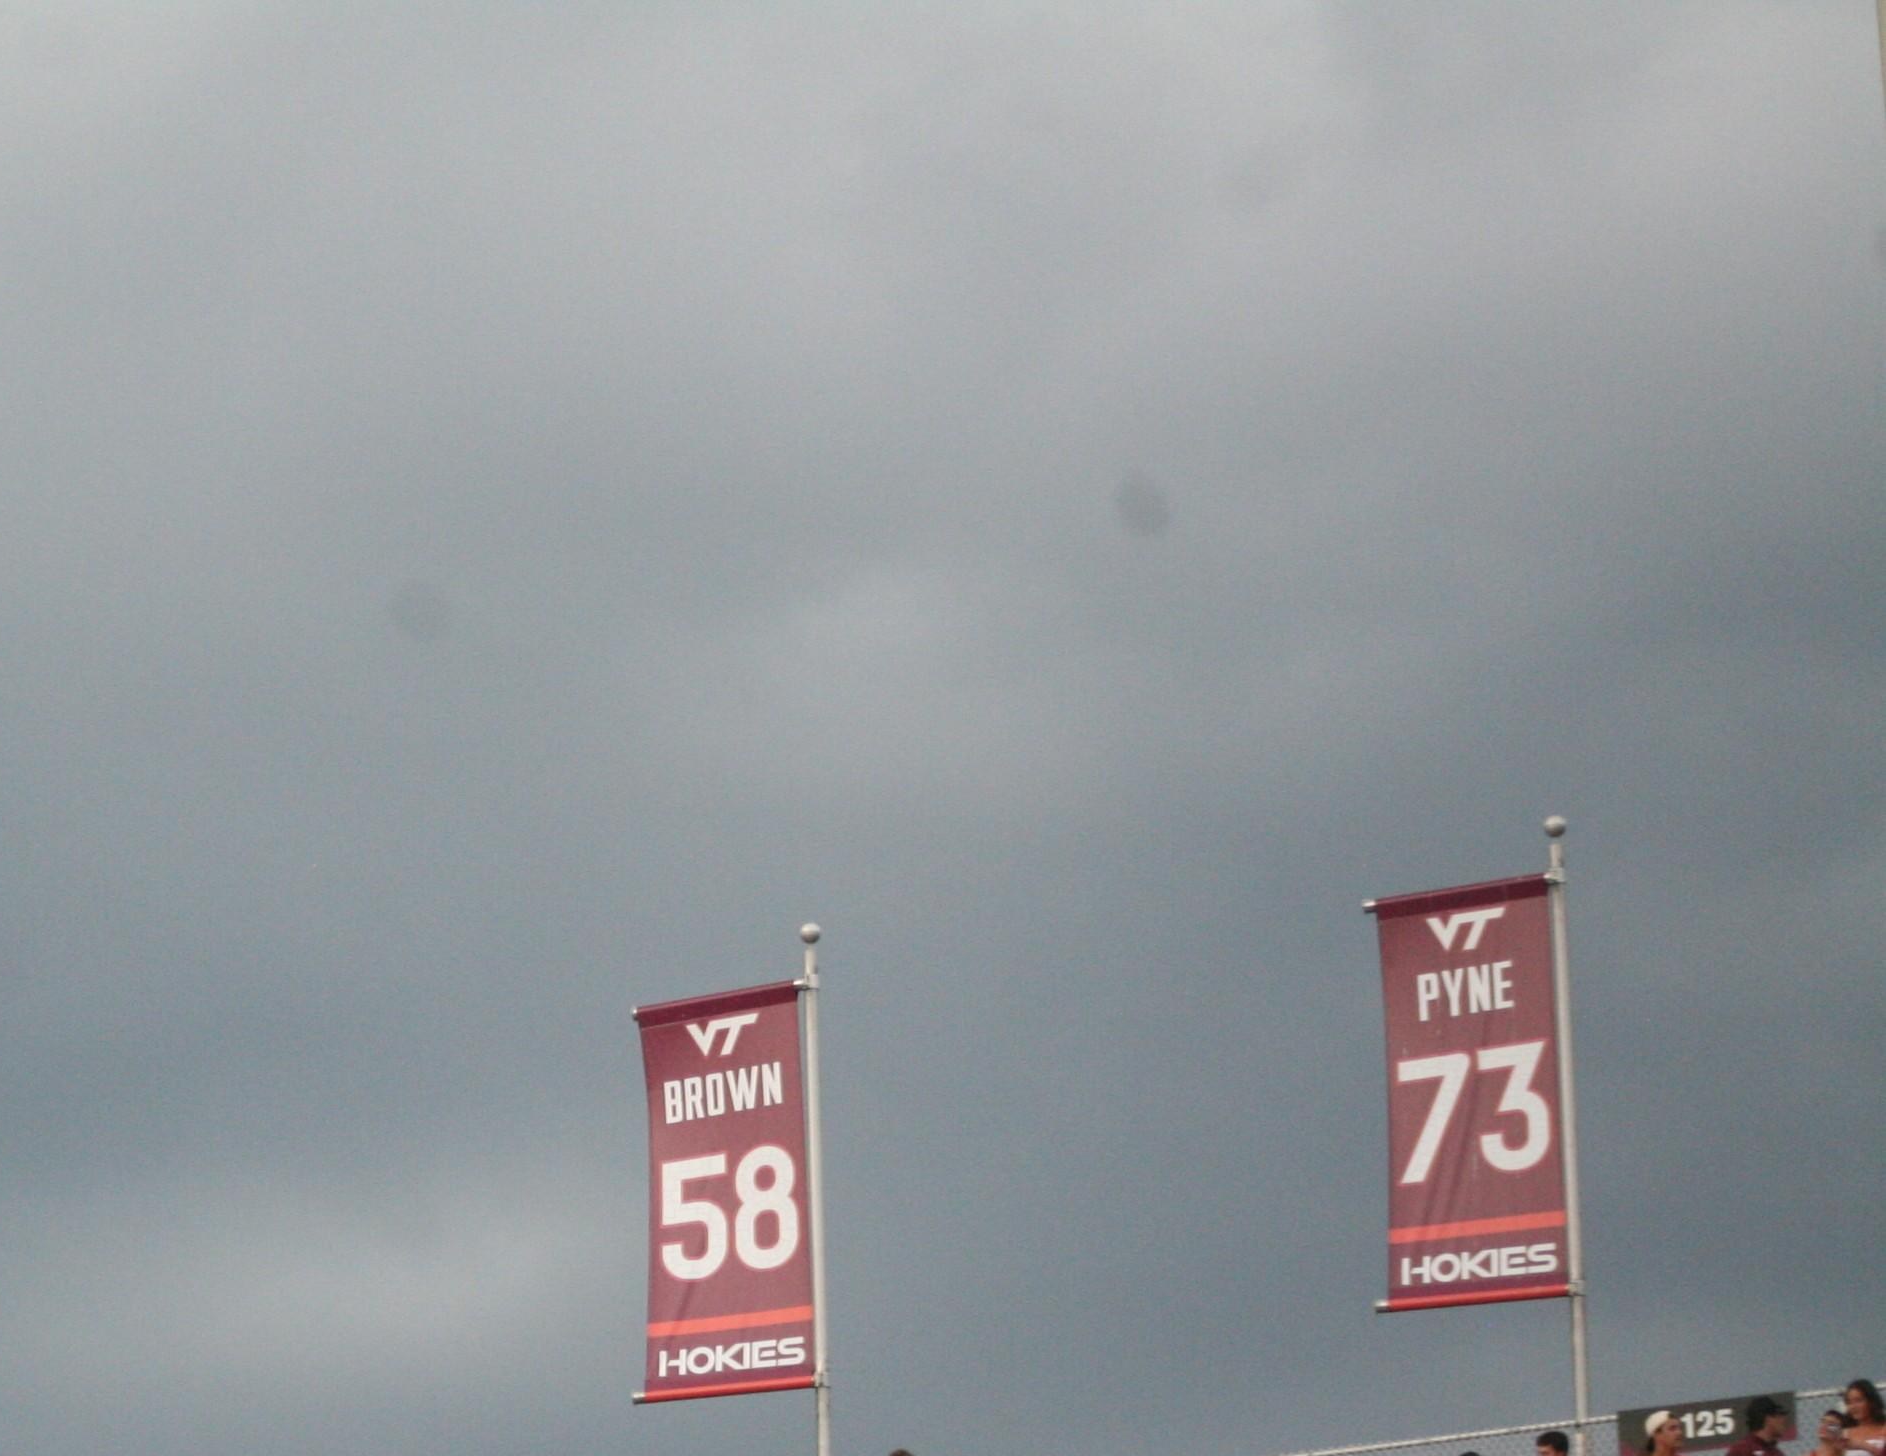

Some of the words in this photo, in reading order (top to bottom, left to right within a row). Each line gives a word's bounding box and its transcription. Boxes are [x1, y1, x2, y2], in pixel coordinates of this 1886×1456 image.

[1417, 961, 1515, 1022] PYNE
[664, 1061, 783, 1124] BROWN
[1397, 1040, 1552, 1185] 73
[661, 1145, 799, 1280] 58
[1401, 1243, 1557, 1287] HOKIES
[658, 1336, 806, 1378] HOKIES
[1681, 1408, 1735, 1439] 125
